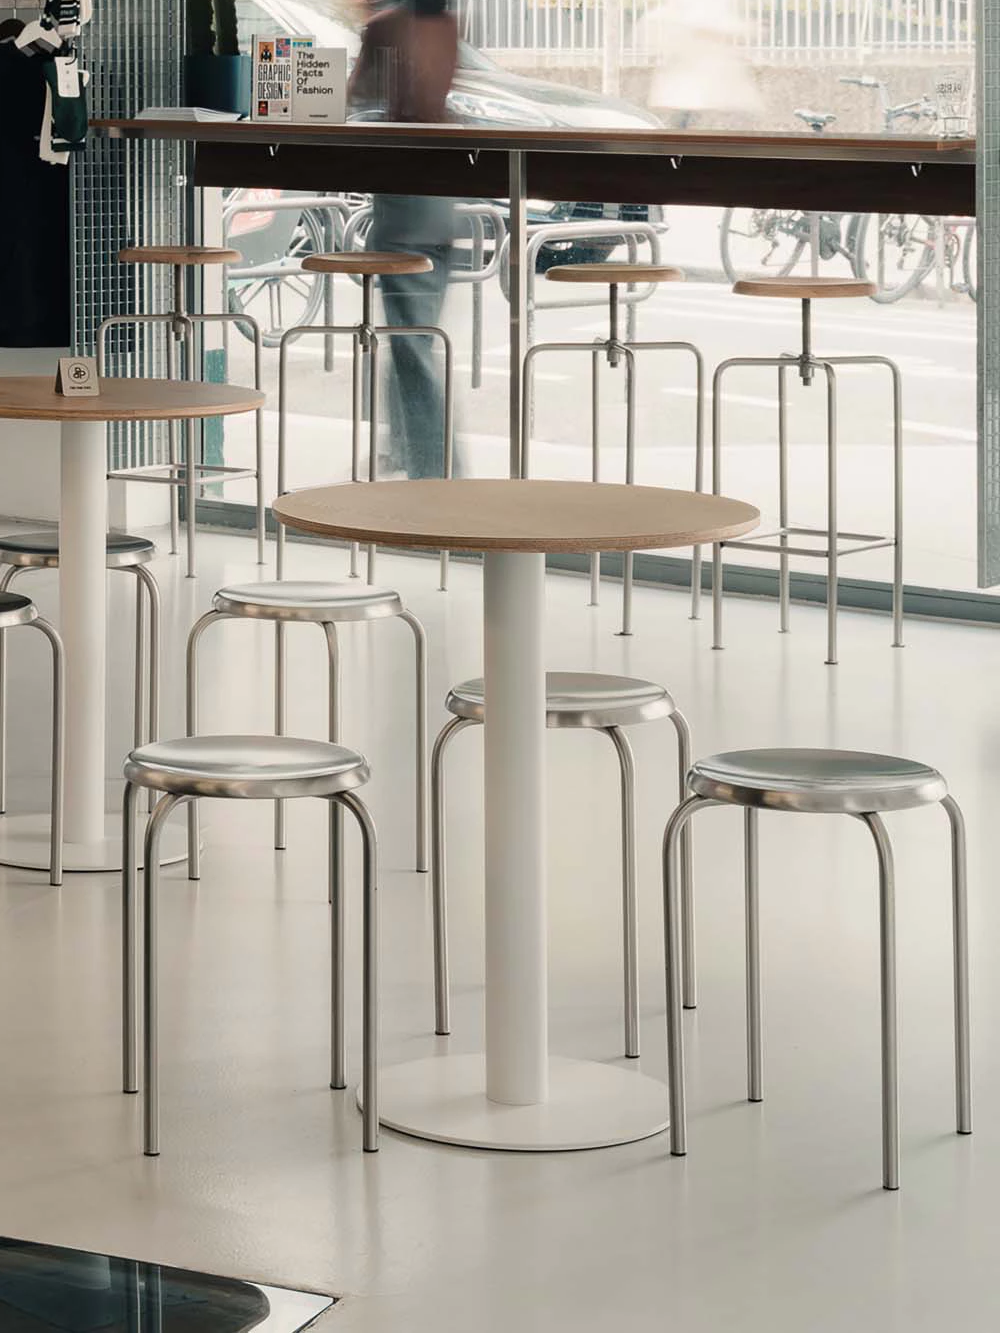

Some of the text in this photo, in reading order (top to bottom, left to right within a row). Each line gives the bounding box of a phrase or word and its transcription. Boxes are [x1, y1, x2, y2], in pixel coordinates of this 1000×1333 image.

[298, 51, 314, 59] The
[297, 60, 330, 68] Hidden
[257, 64, 291, 82] GRAPHIC
[297, 69, 324, 77] Facts
[297, 77, 308, 86] Of
[257, 82, 283, 99] DESIGN
[297, 86, 334, 94] Fashion
